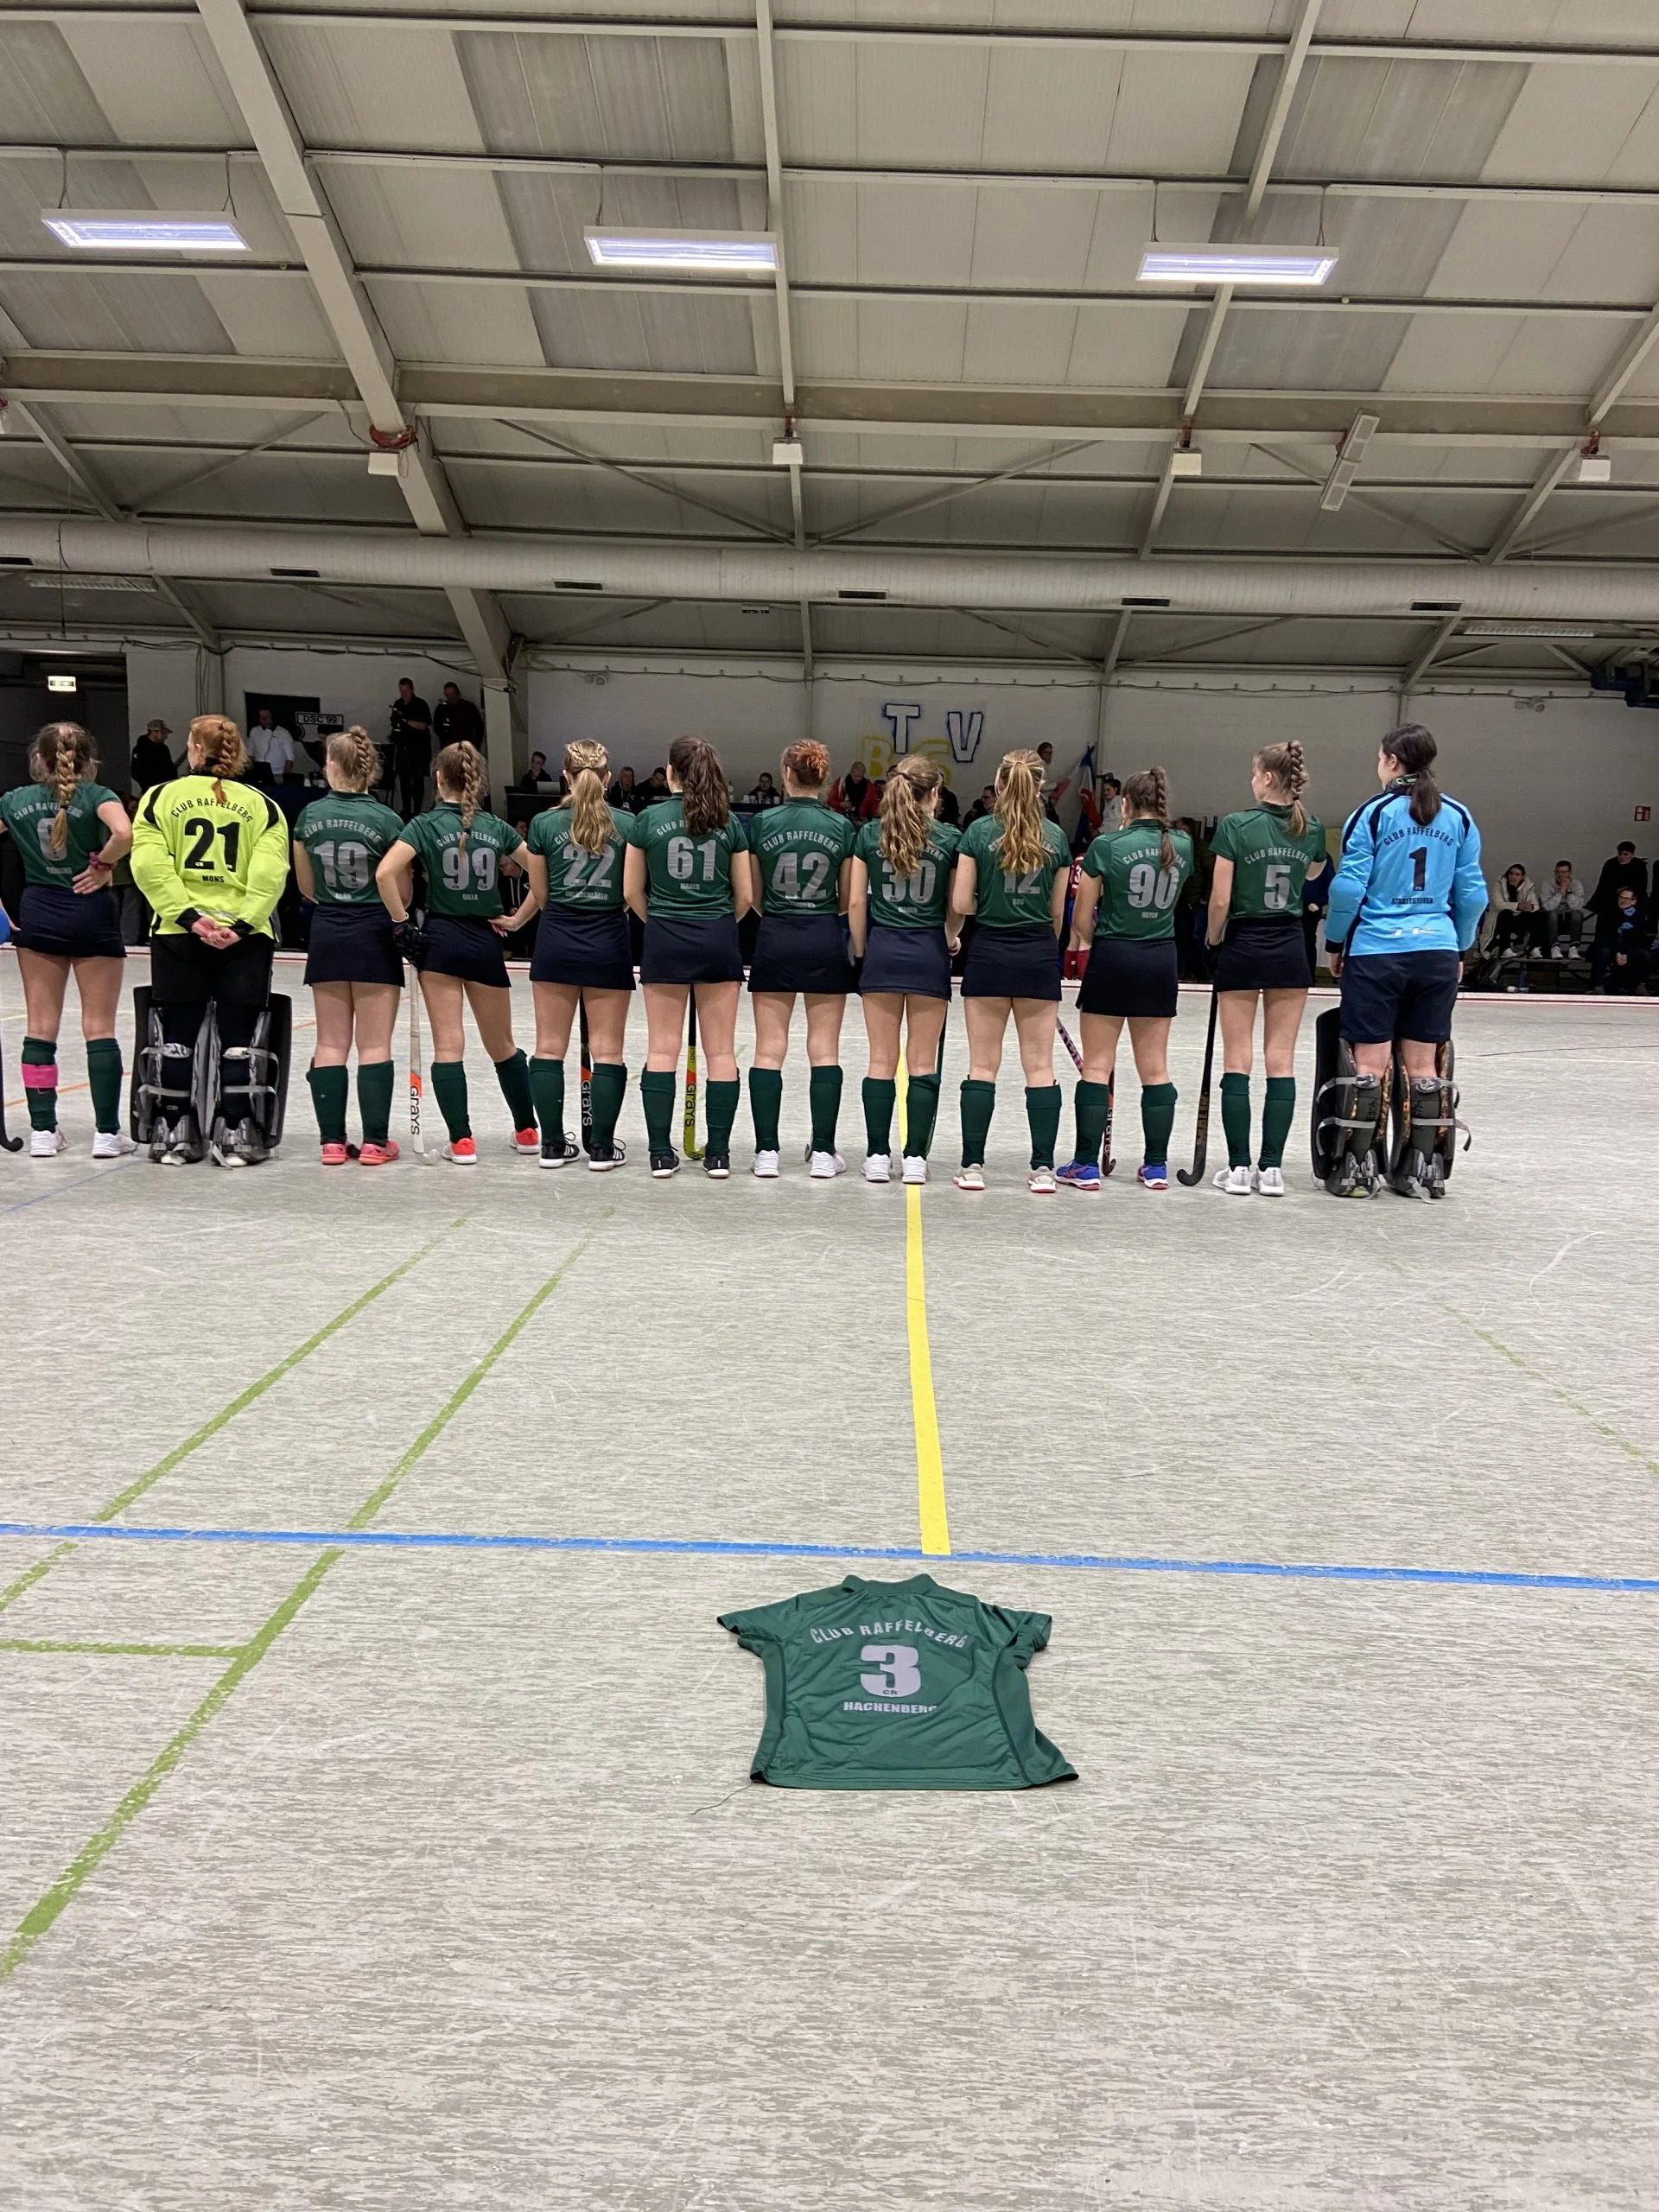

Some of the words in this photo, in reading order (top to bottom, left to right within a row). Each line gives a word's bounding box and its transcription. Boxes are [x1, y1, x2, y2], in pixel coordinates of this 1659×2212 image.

[303, 715, 323, 723] DSC
[13, 804, 34, 820] CLUB
[171, 799, 194, 817] CLUB
[304, 821, 323, 838] CLUB
[326, 819, 382, 842] RAFFELBERG
[435, 832, 455, 847] CLUB
[554, 830, 569, 845] CLU
[657, 821, 677, 836] CLUB
[762, 834, 785, 851] CLUB
[786, 830, 840, 853] RAFFELBERG
[1383, 829, 1404, 846] CLUB
[1407, 827, 1453, 846] RAFFELBERG
[184, 817, 240, 873] 21
[667, 836, 716, 880] 61
[1122, 849, 1143, 865] CLUB
[1244, 849, 1266, 864] CLUB
[314, 840, 369, 889] 19
[442, 847, 496, 891] 99
[563, 843, 615, 888] 22
[772, 851, 830, 899] 42
[1408, 847, 1427, 891] 1
[882, 859, 936, 904] 30
[1128, 863, 1179, 910] 90
[1264, 864, 1292, 909] 5
[810, 1627, 855, 1643] CLUB
[860, 1619, 969, 1648] RAFFELBERG
[860, 1644, 921, 1698] 3
